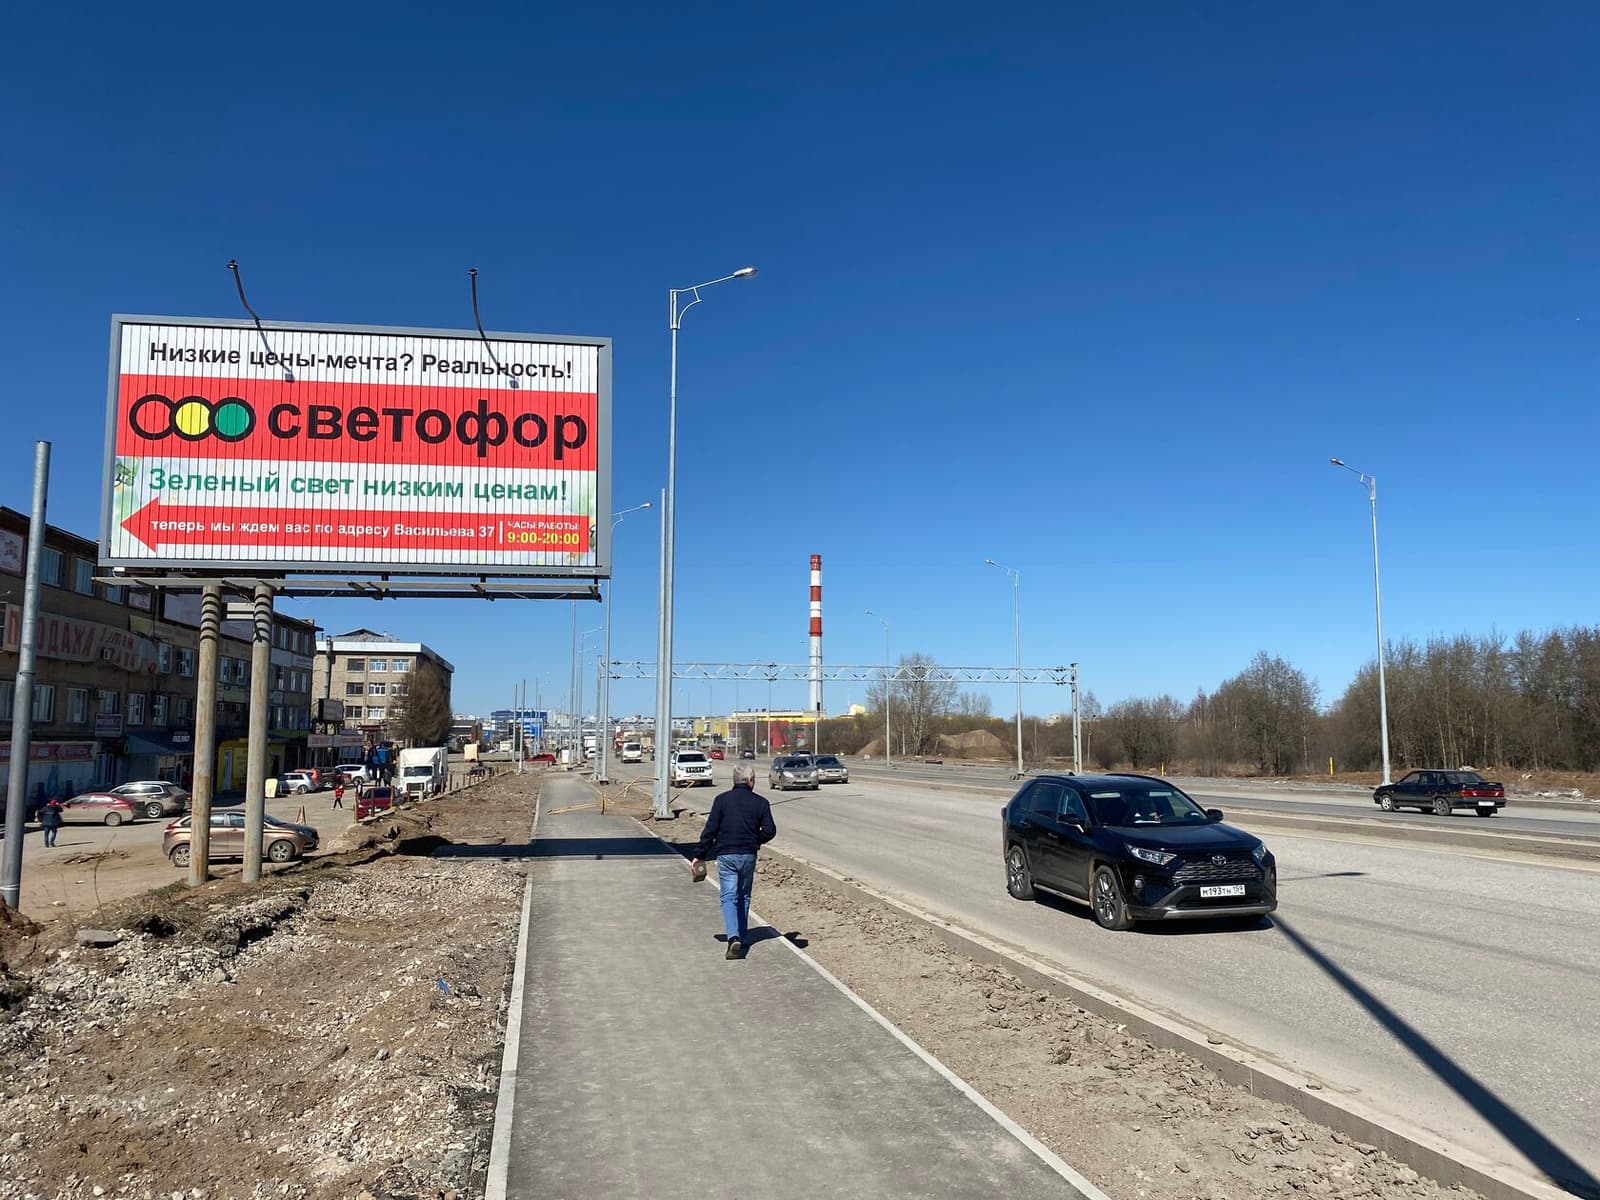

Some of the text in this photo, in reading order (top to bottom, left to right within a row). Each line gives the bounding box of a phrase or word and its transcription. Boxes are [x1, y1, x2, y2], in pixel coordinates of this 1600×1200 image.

[150, 342, 572, 379] Низкие цены-мечта? Реальность!
[268, 399, 587, 460] светофор
[149, 468, 567, 502] Зеленый свет низким ценам!
[151, 520, 495, 538] теперь мы ждем вас по адресу Васильева 37
[507, 521, 578, 531] ЧАСЫ РАБОТЫ
[507, 531, 580, 544] 9:00-20:00
[7, 609, 96, 657] ПОДАЖИ
